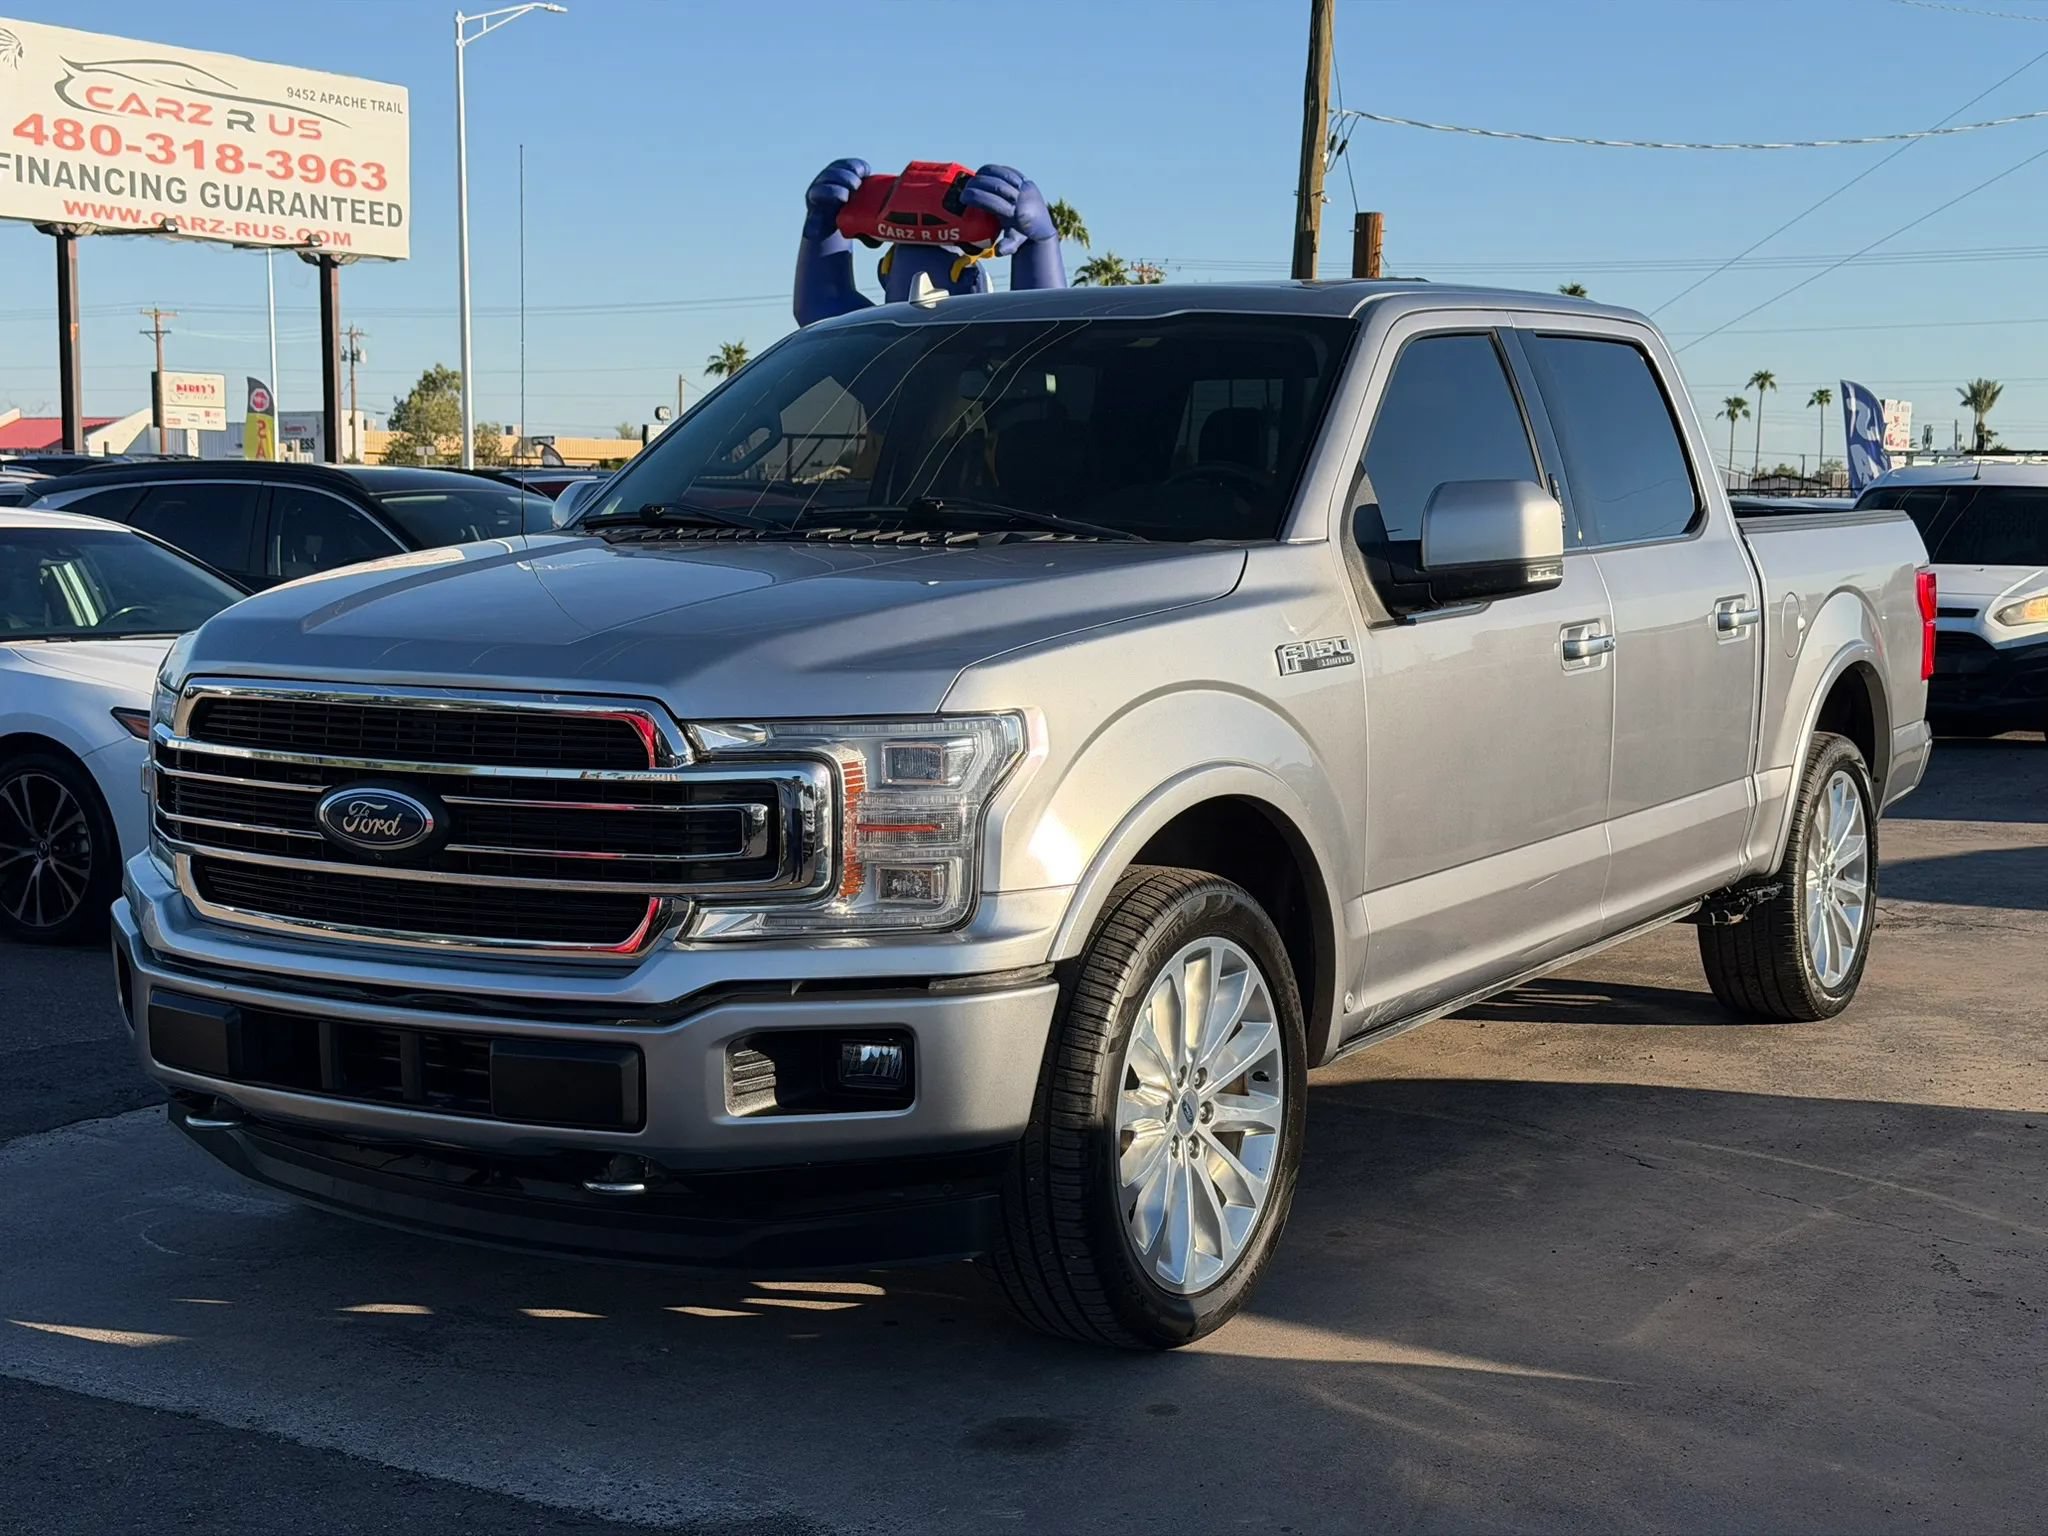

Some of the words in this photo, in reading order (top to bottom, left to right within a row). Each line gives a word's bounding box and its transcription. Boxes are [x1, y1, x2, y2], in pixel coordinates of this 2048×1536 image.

[85, 86, 213, 126] CARZ
[227, 109, 255, 133] R
[268, 113, 322, 140] US
[287, 87, 315, 101] 9452
[320, 93, 367, 109] APACHE
[370, 100, 403, 114] TRAIL
[13, 113, 388, 192] 480-318-3963
[200, 181, 403, 228] GUARANTEED
[877, 224, 915, 239] CARZ
[921, 231, 931, 240] R
[938, 228, 960, 241] US
[342, 800, 403, 836] Ford
